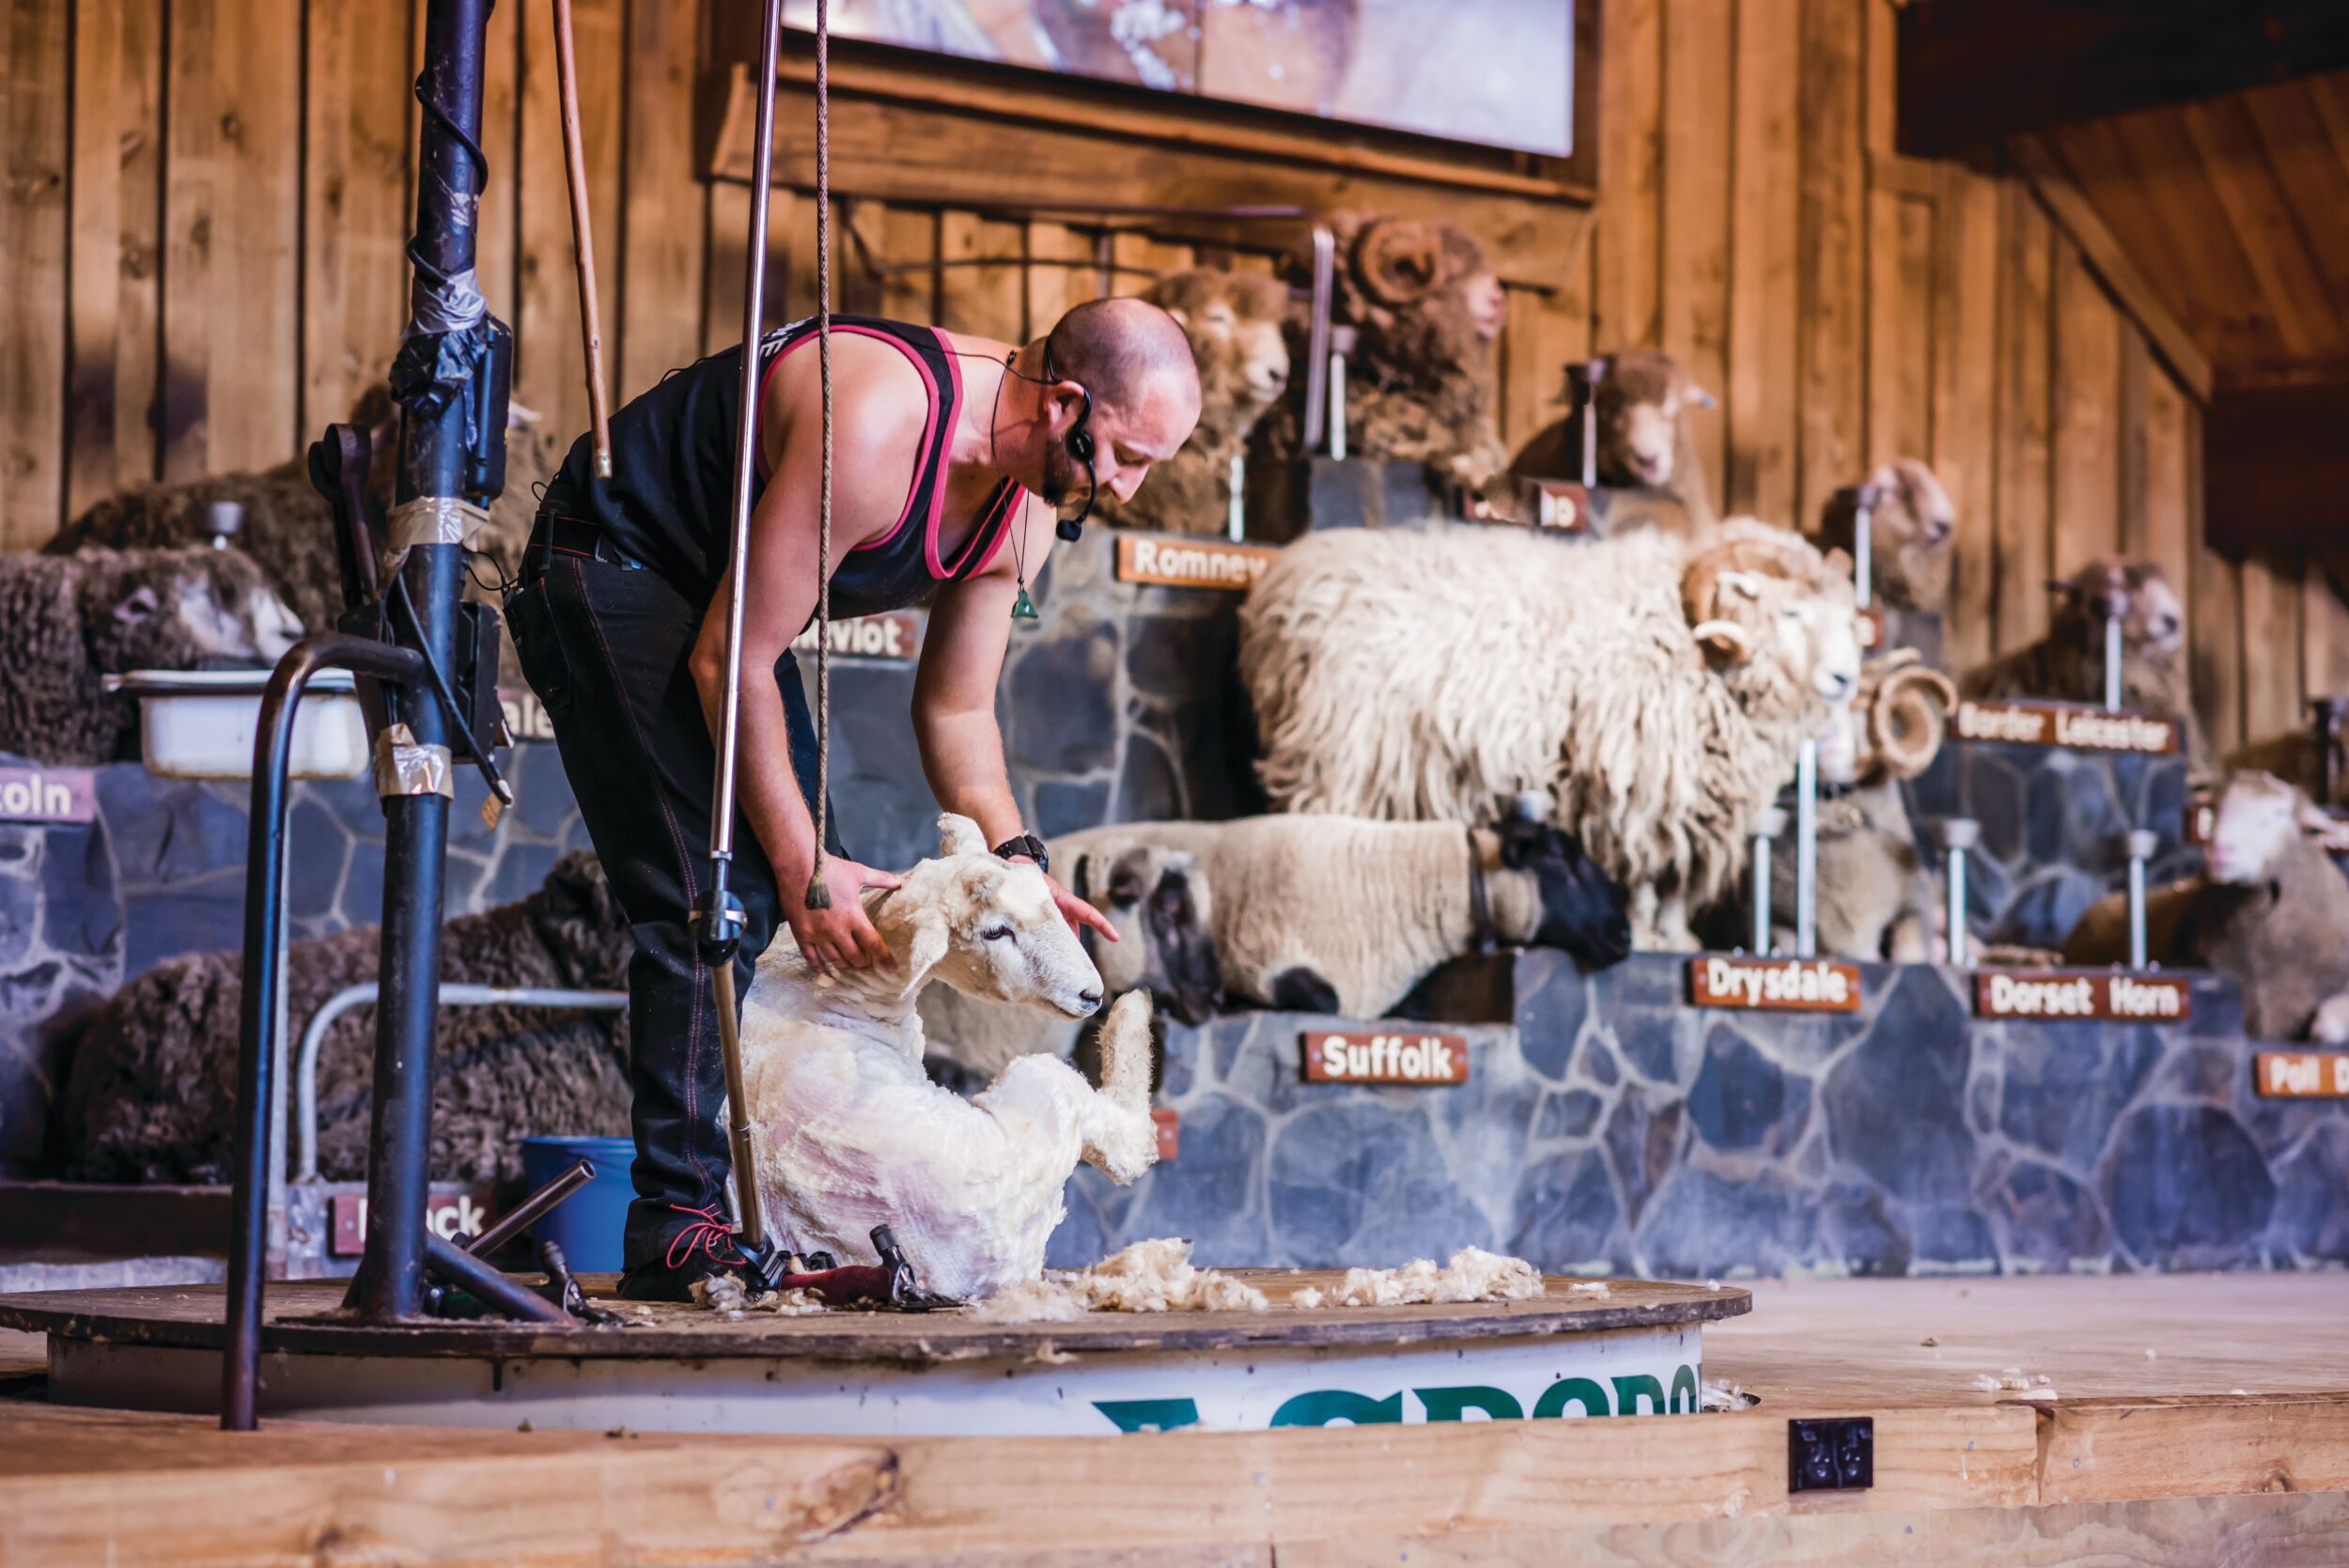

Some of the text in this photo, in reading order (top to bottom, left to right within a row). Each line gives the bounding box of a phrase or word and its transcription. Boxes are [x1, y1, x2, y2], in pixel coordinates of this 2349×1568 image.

[0, 772, 71, 816] oln
[1707, 957, 1848, 1006] Drysdale
[1990, 974, 2180, 1016] Dorset Horn
[1323, 1035, 1454, 1079] Suffolk
